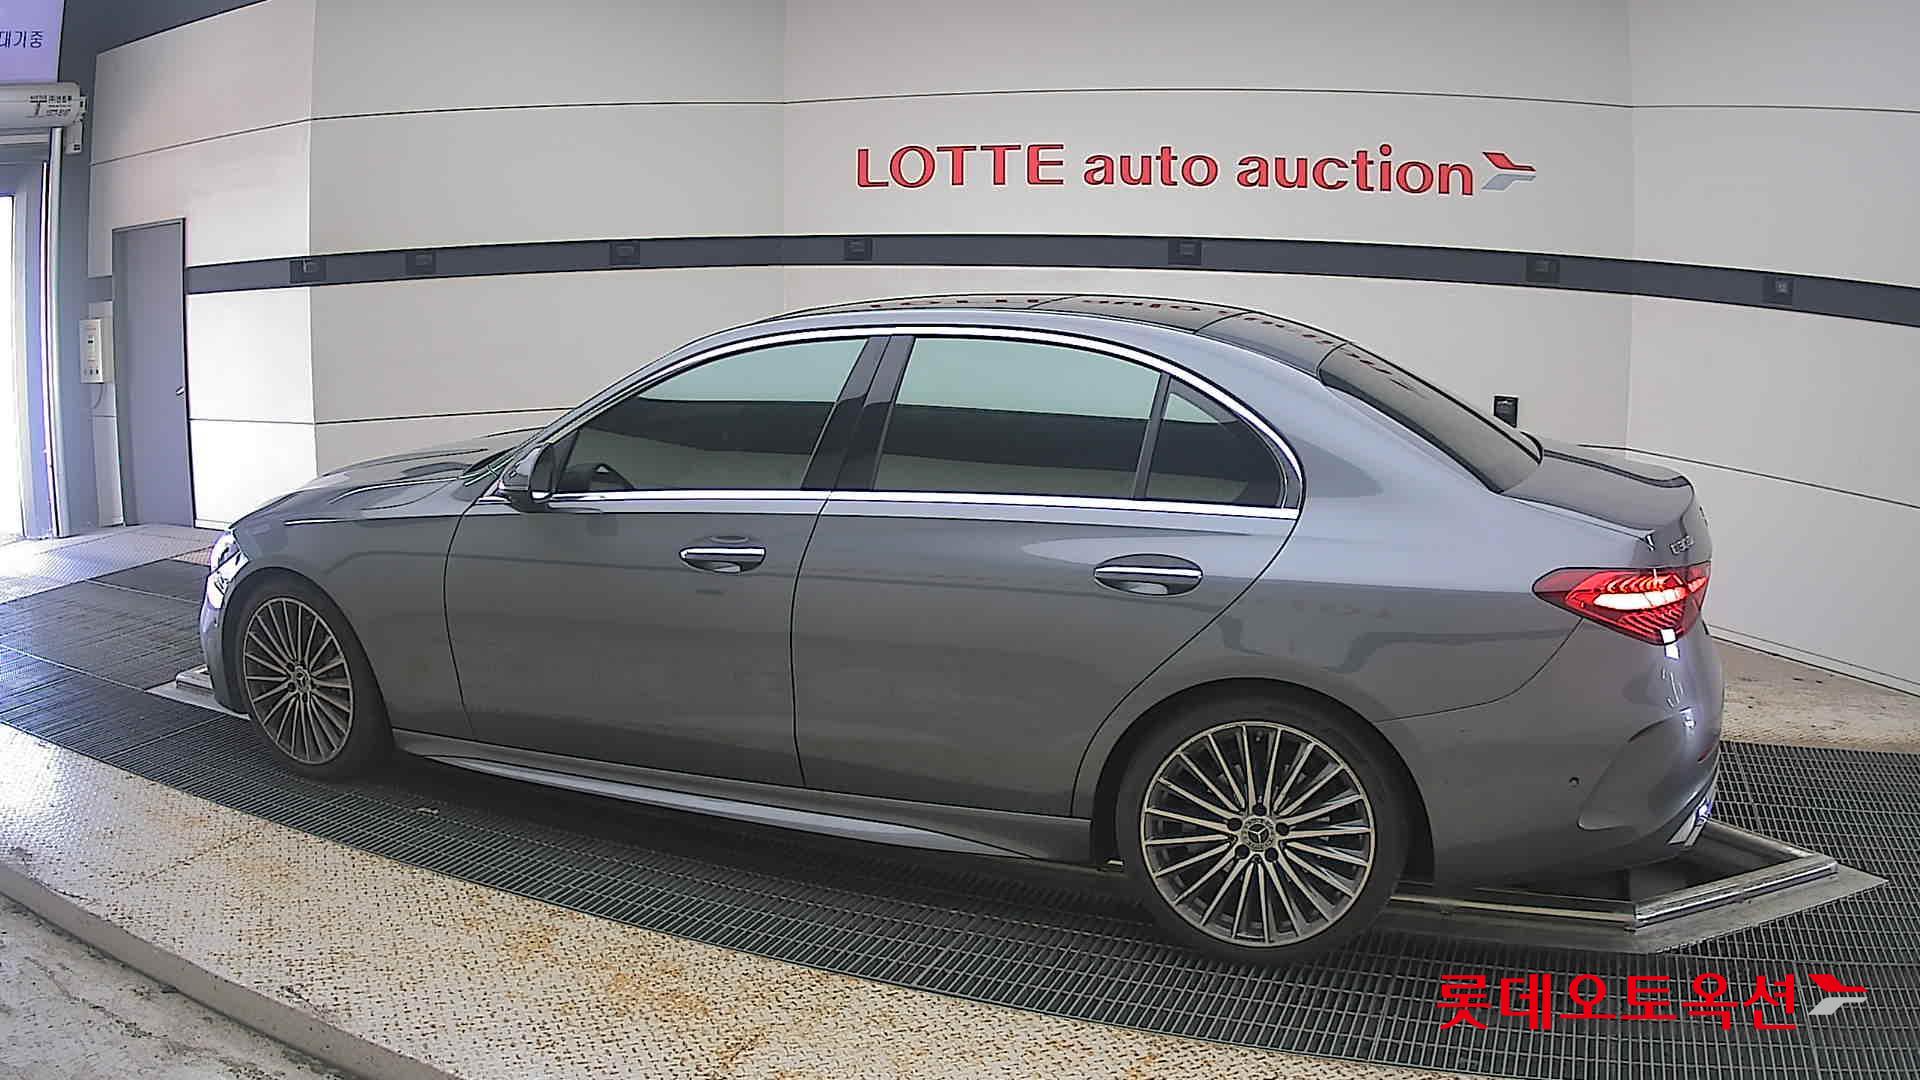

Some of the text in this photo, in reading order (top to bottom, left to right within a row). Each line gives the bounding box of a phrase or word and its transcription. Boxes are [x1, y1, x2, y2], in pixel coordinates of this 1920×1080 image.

[857, 144, 1474, 196] LOTTE auto auction
